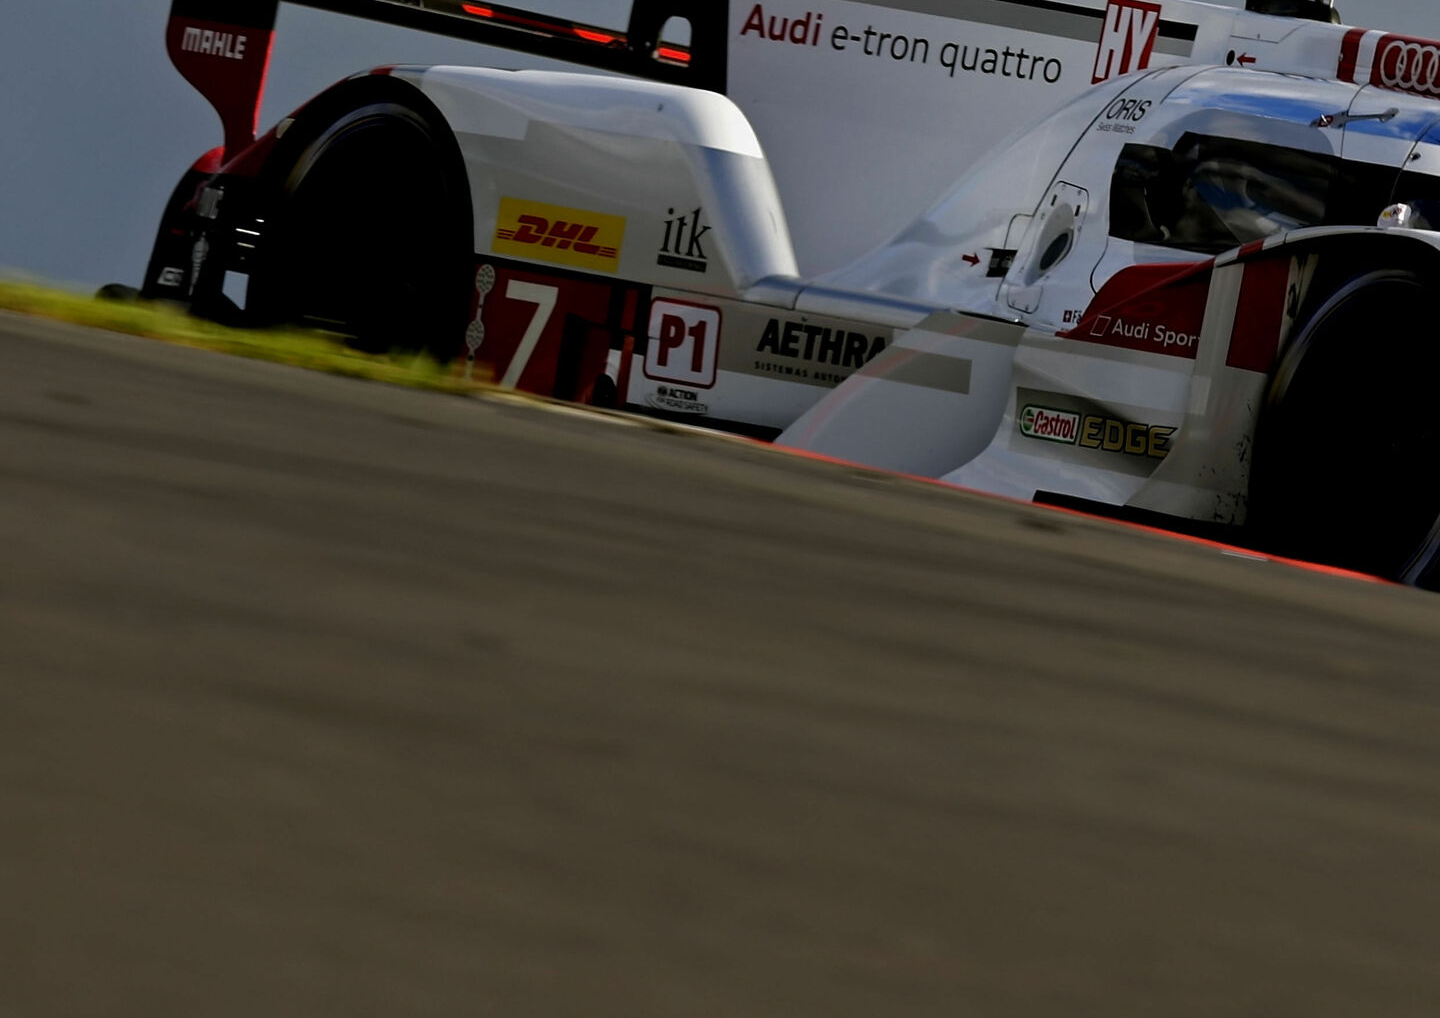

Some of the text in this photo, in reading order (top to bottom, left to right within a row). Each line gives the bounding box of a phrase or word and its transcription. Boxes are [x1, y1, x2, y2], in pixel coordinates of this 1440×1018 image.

[181, 26, 248, 60] MAHLE
[740, 3, 1062, 84] Audi e-tron quattro
[1095, 4, 1158, 81] HY
[1106, 98, 1153, 122] ORIS
[512, 214, 604, 256] DHL
[660, 207, 712, 260] itk
[500, 279, 559, 391] 7
[656, 313, 707, 374] P1
[756, 317, 886, 369] AETHRA
[1112, 318, 1149, 340] Audi
[754, 360, 808, 378] SISTEMAS
[1033, 410, 1076, 440] Castrol
[1079, 414, 1178, 459] EDGE
